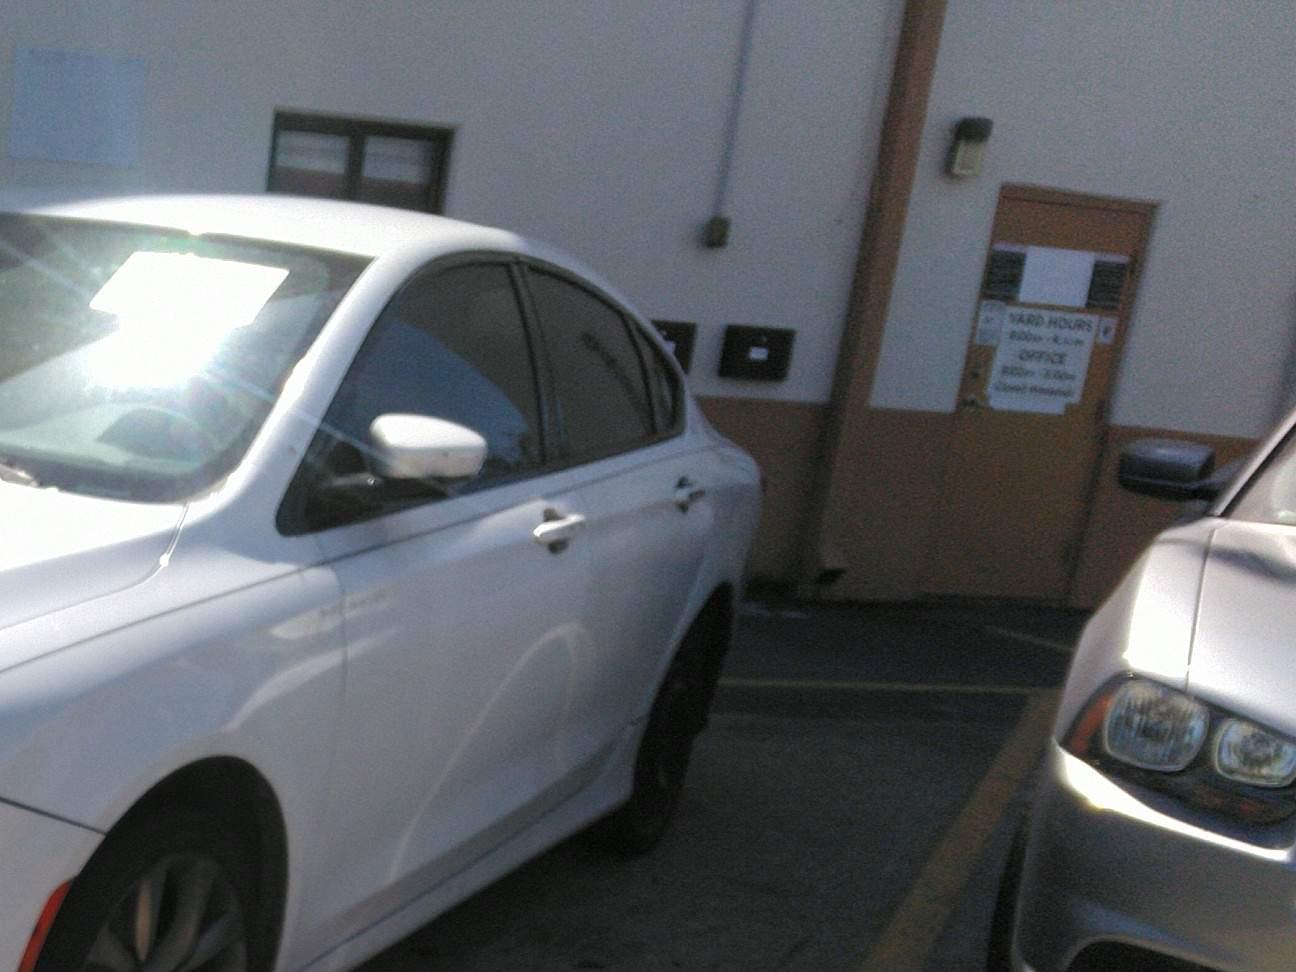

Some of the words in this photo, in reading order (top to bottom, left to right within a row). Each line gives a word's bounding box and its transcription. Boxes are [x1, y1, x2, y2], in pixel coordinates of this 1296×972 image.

[1010, 313, 1045, 327] YARD
[1048, 316, 1093, 332] HOURS
[1020, 349, 1068, 364] OFFICE
